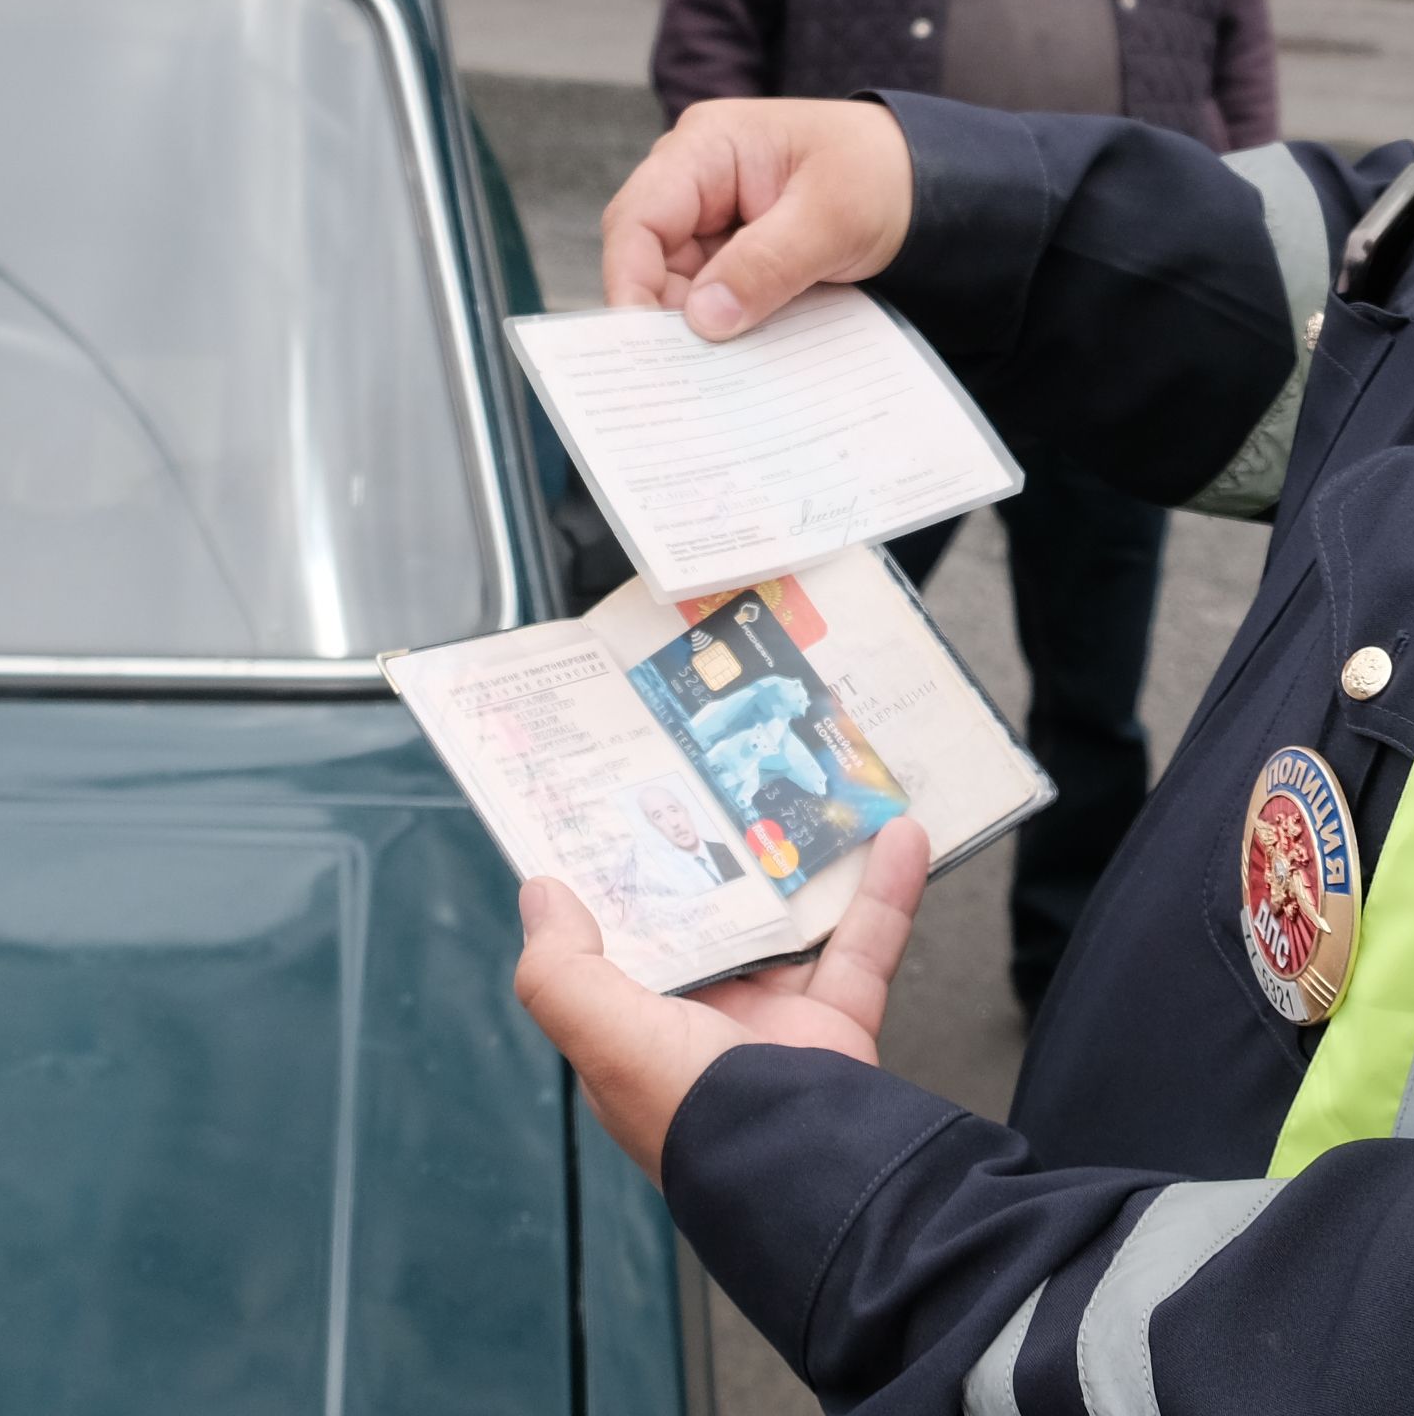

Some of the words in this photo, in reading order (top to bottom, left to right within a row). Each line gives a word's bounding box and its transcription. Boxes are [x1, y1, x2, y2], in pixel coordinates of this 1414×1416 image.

[859, 680, 939, 734] ЕДЕРАЦИИ
[813, 721, 853, 772] КОМАНДА
[823, 716, 865, 769] СЕМЕЙНАЯ
[1266, 756, 1346, 886] ПОЛИЦИЯ
[1253, 897, 1291, 970] ДПС
